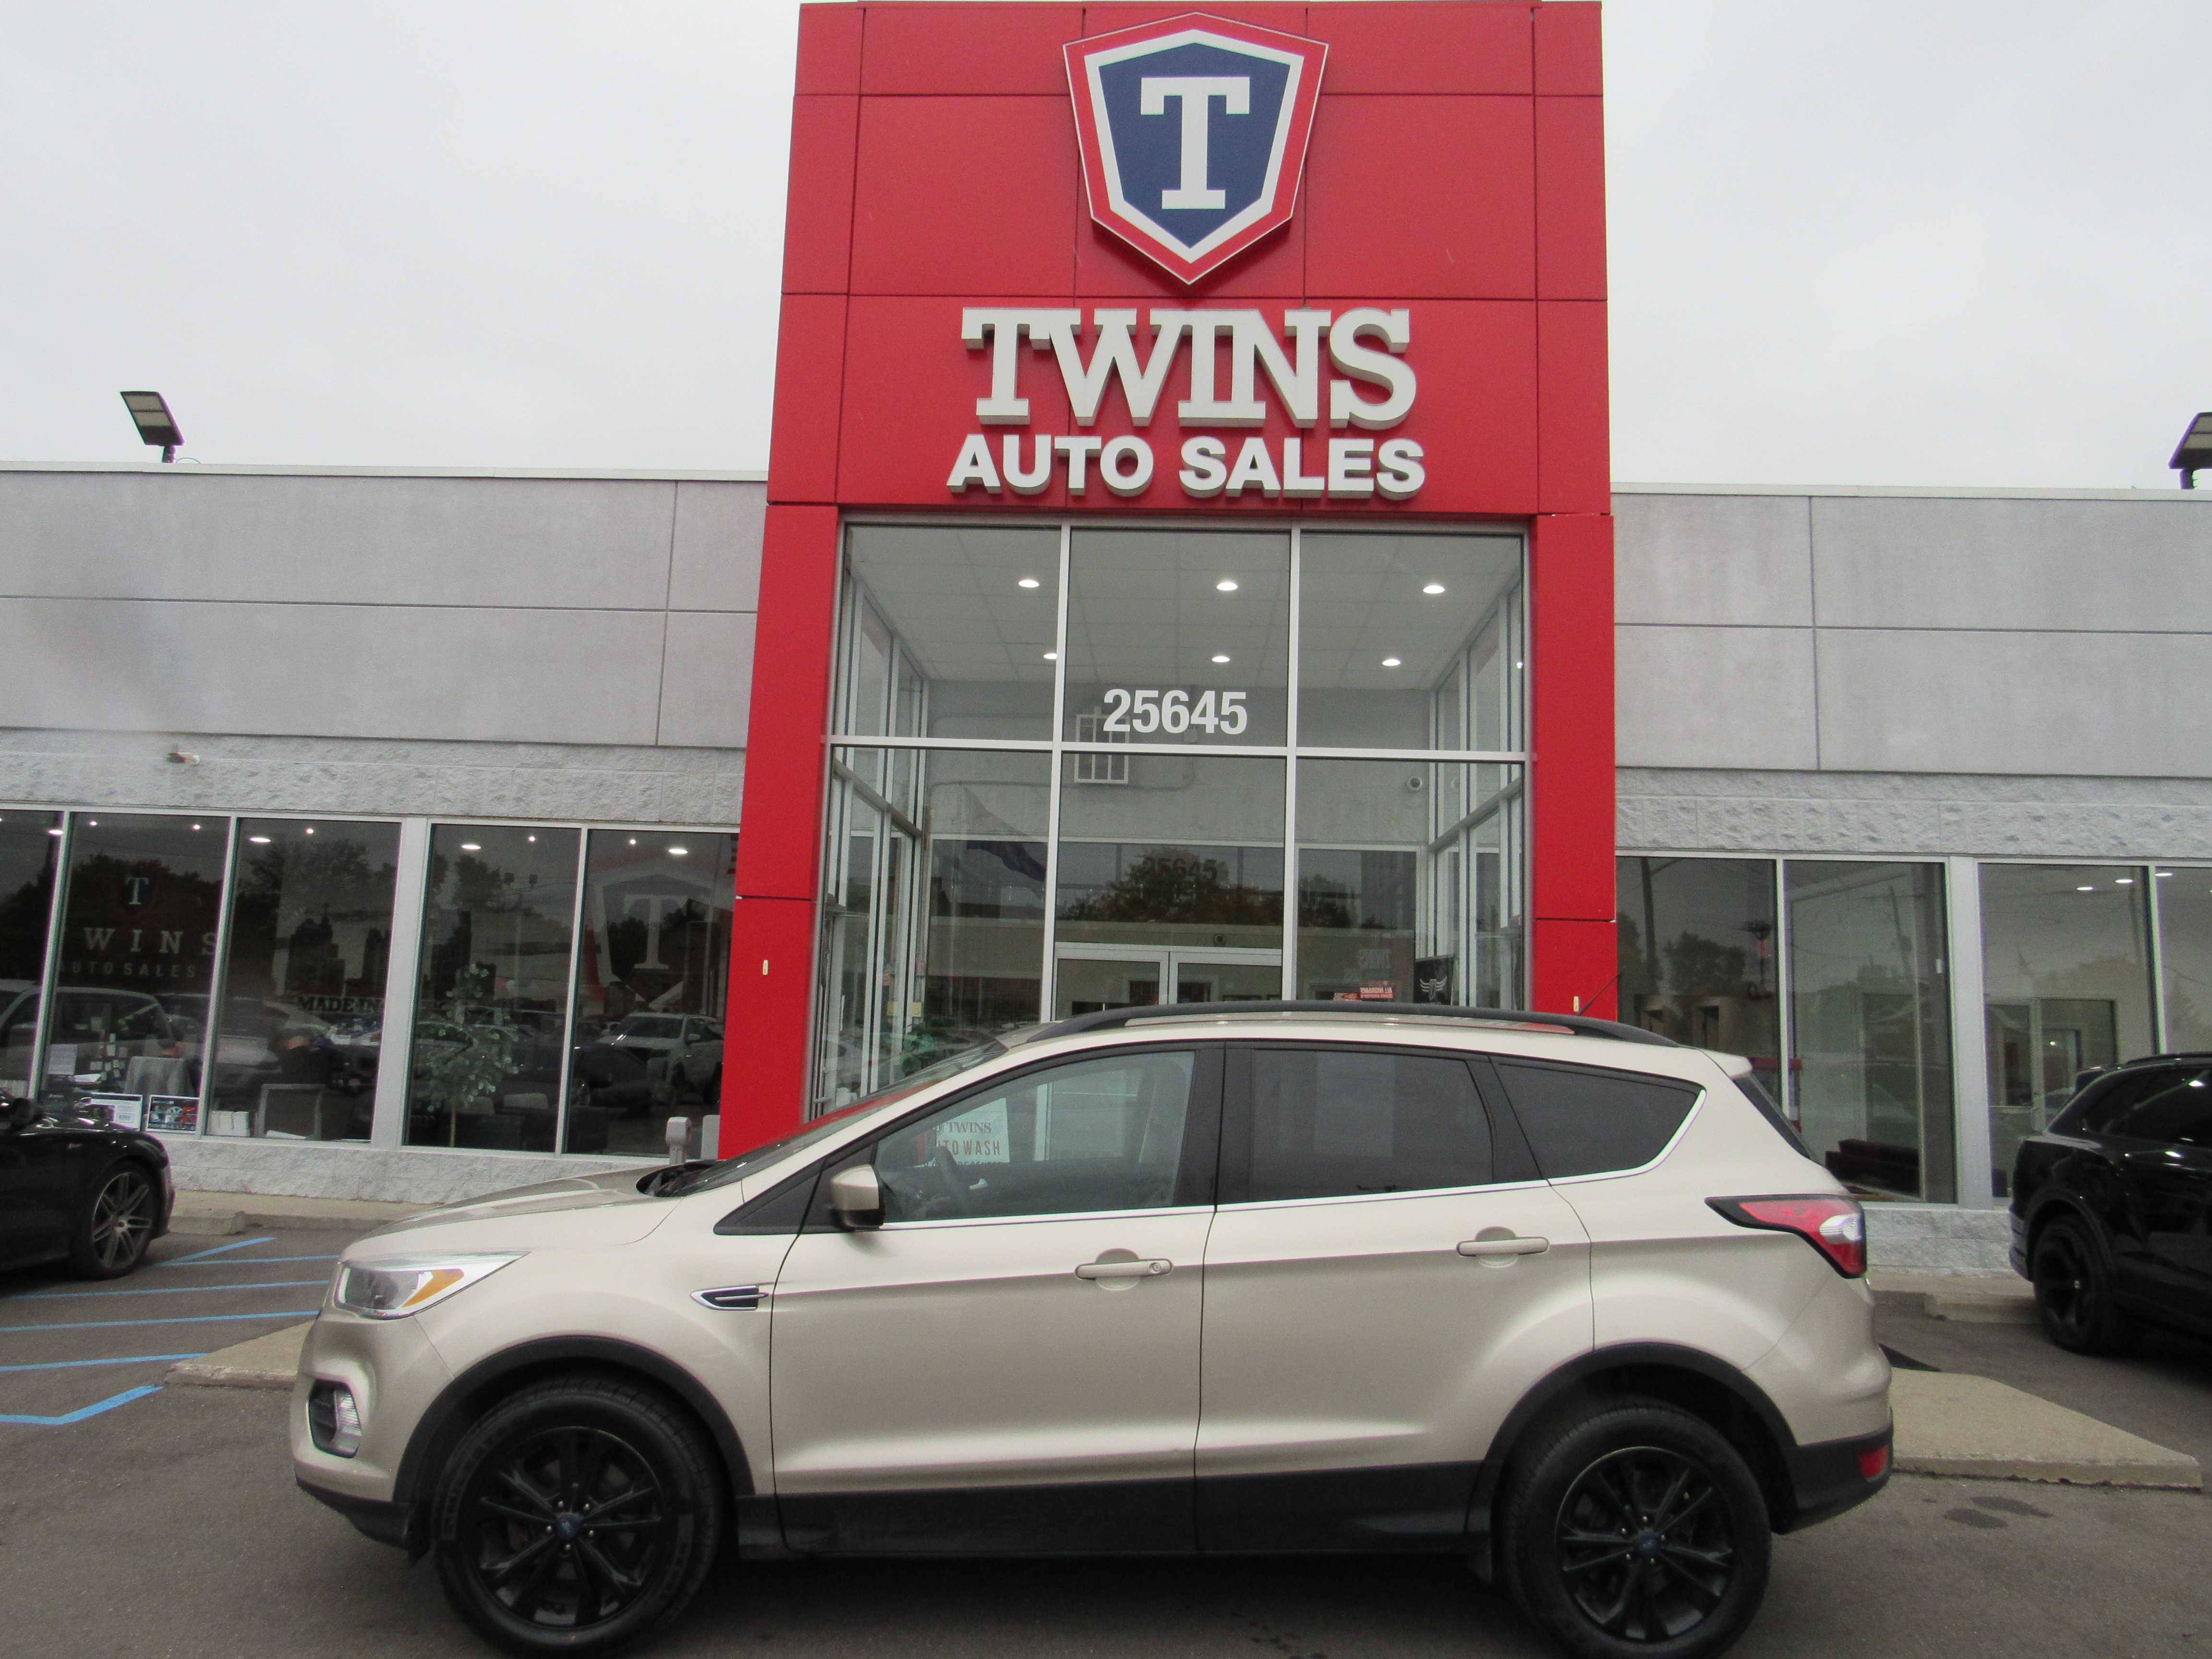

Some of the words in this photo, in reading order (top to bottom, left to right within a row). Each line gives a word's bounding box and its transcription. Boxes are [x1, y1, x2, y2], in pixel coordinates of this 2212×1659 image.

[1141, 76, 1250, 209] T
[961, 307, 1417, 430] TWINS
[947, 434, 1154, 497] AUTO
[1178, 436, 1425, 500] SALES
[1103, 688, 1248, 735] 25645
[123, 963, 196, 978] SALES
[298, 996, 354, 1012] MADE
[947, 1121, 992, 1133] TWINS
[963, 1140, 1000, 1155] WASH
